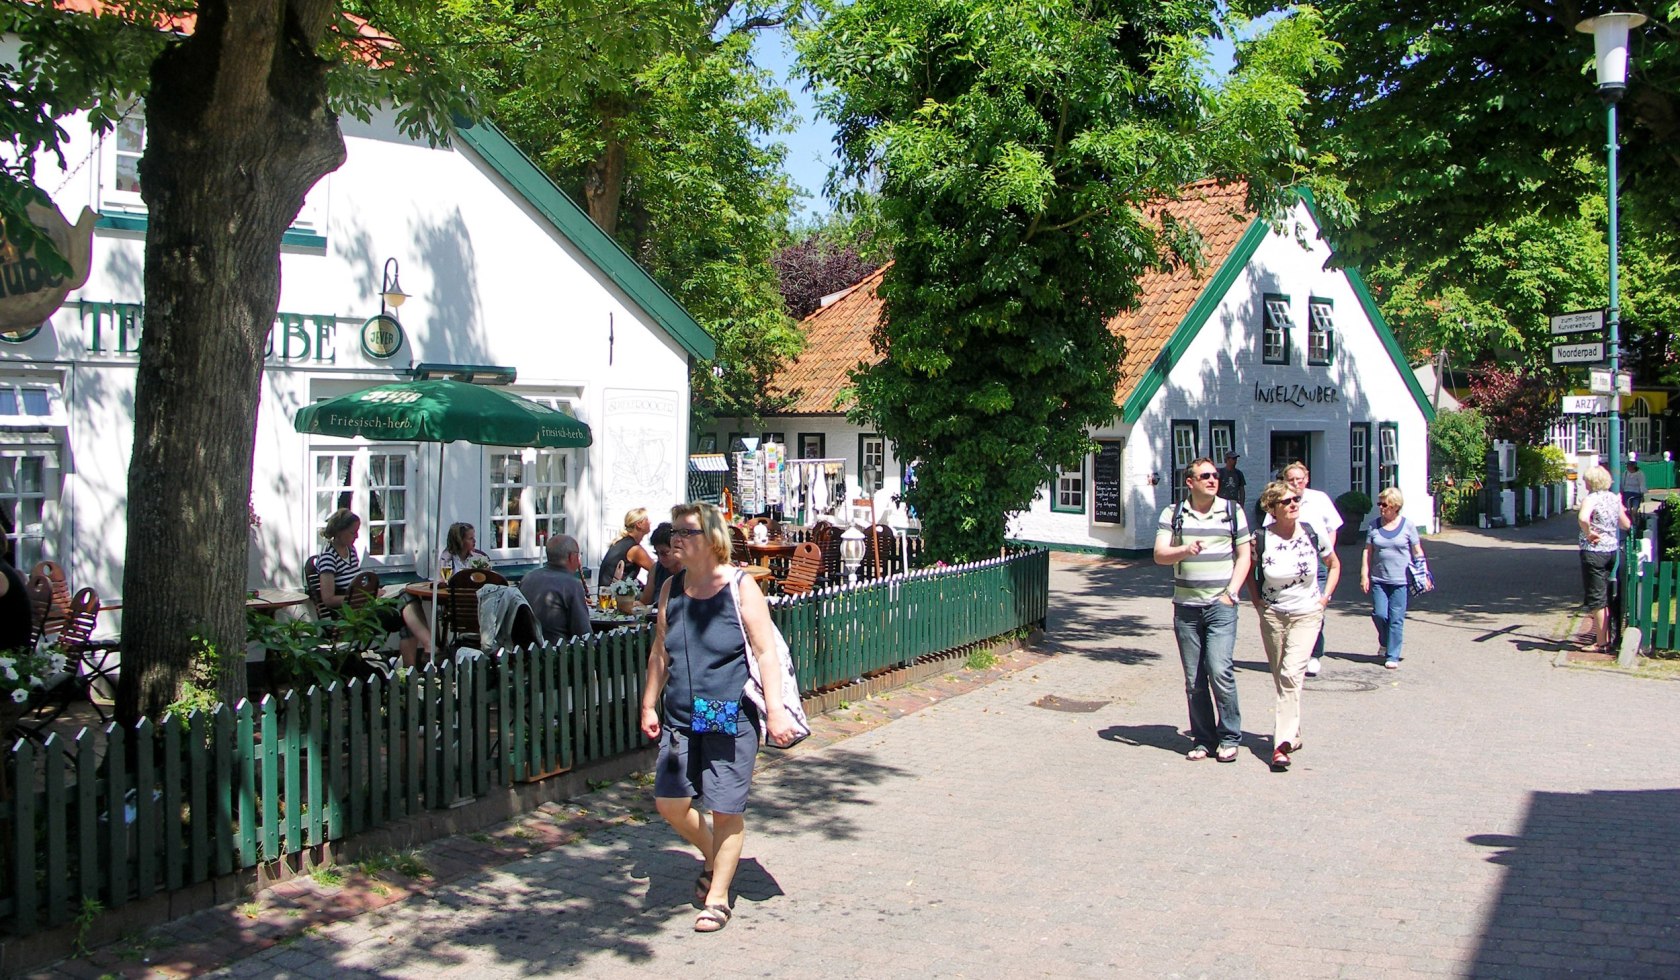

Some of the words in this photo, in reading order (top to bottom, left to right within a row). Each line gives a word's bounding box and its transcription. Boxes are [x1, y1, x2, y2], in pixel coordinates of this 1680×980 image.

[1575, 314, 1593, 322] Strand
[1558, 321, 1596, 330] Kurverwaltung
[370, 331, 394, 345] JEVER
[1558, 346, 1597, 358] Noorderpad
[360, 390, 423, 404] JEVER
[1575, 399, 1597, 409] ARZT
[330, 414, 413, 429] Friesisch-herb.
[541, 425, 586, 440] Friesisch-herb.
